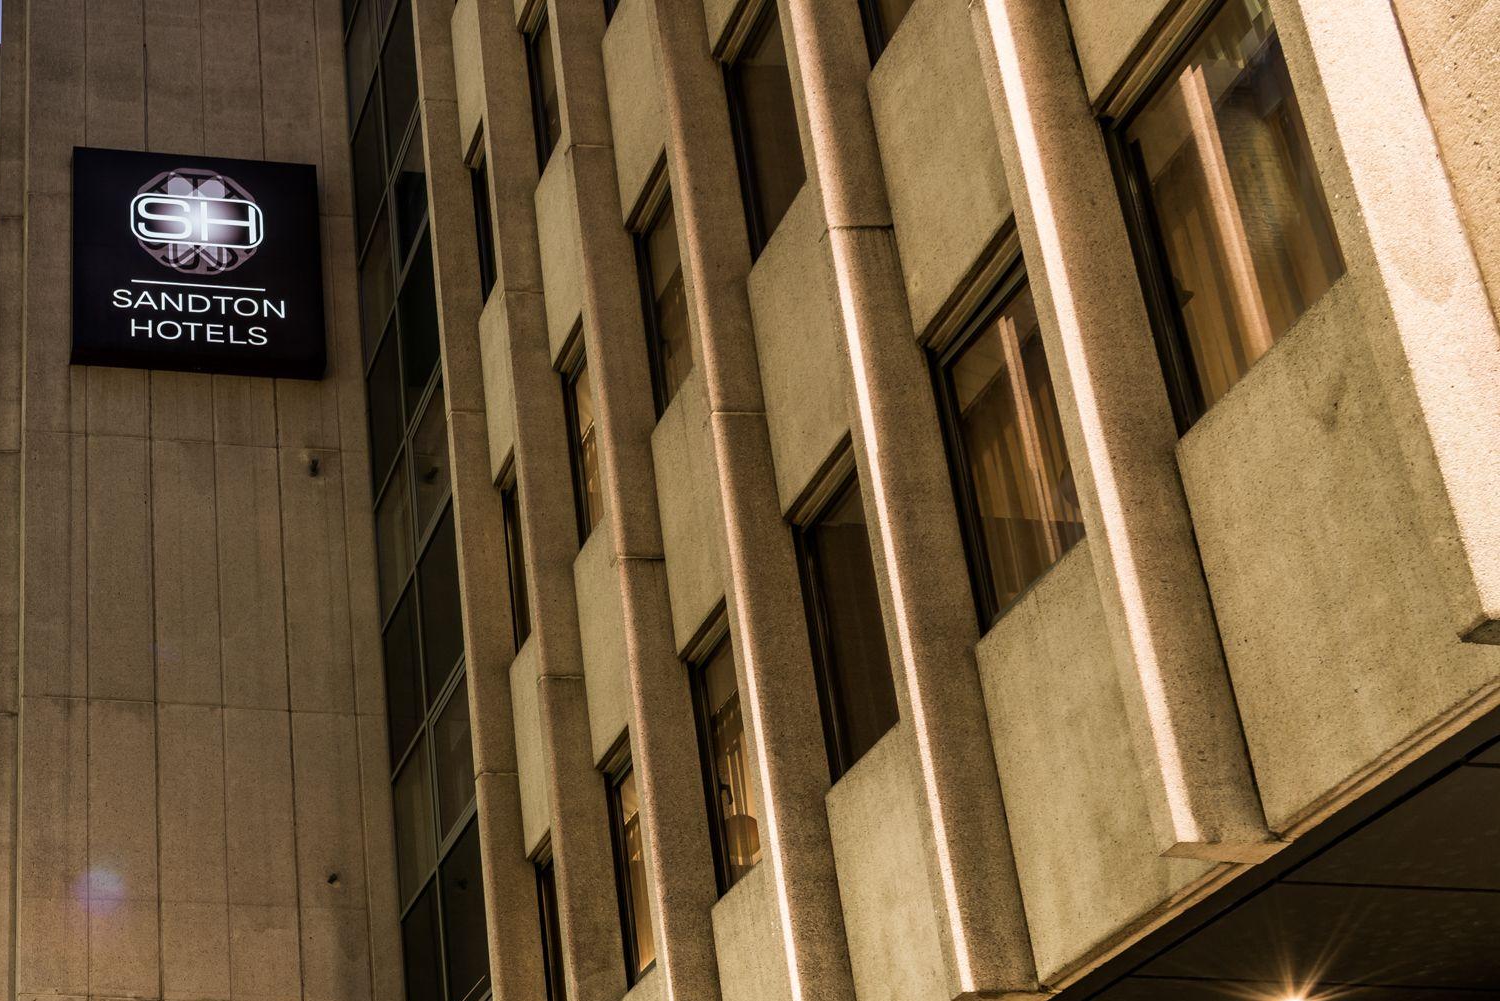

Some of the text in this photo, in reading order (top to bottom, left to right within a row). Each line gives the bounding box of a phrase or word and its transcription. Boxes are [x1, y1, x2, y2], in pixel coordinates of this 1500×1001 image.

[136, 196, 257, 245] SH
[112, 288, 287, 319] SANDTON
[130, 318, 269, 346] HOTELS
